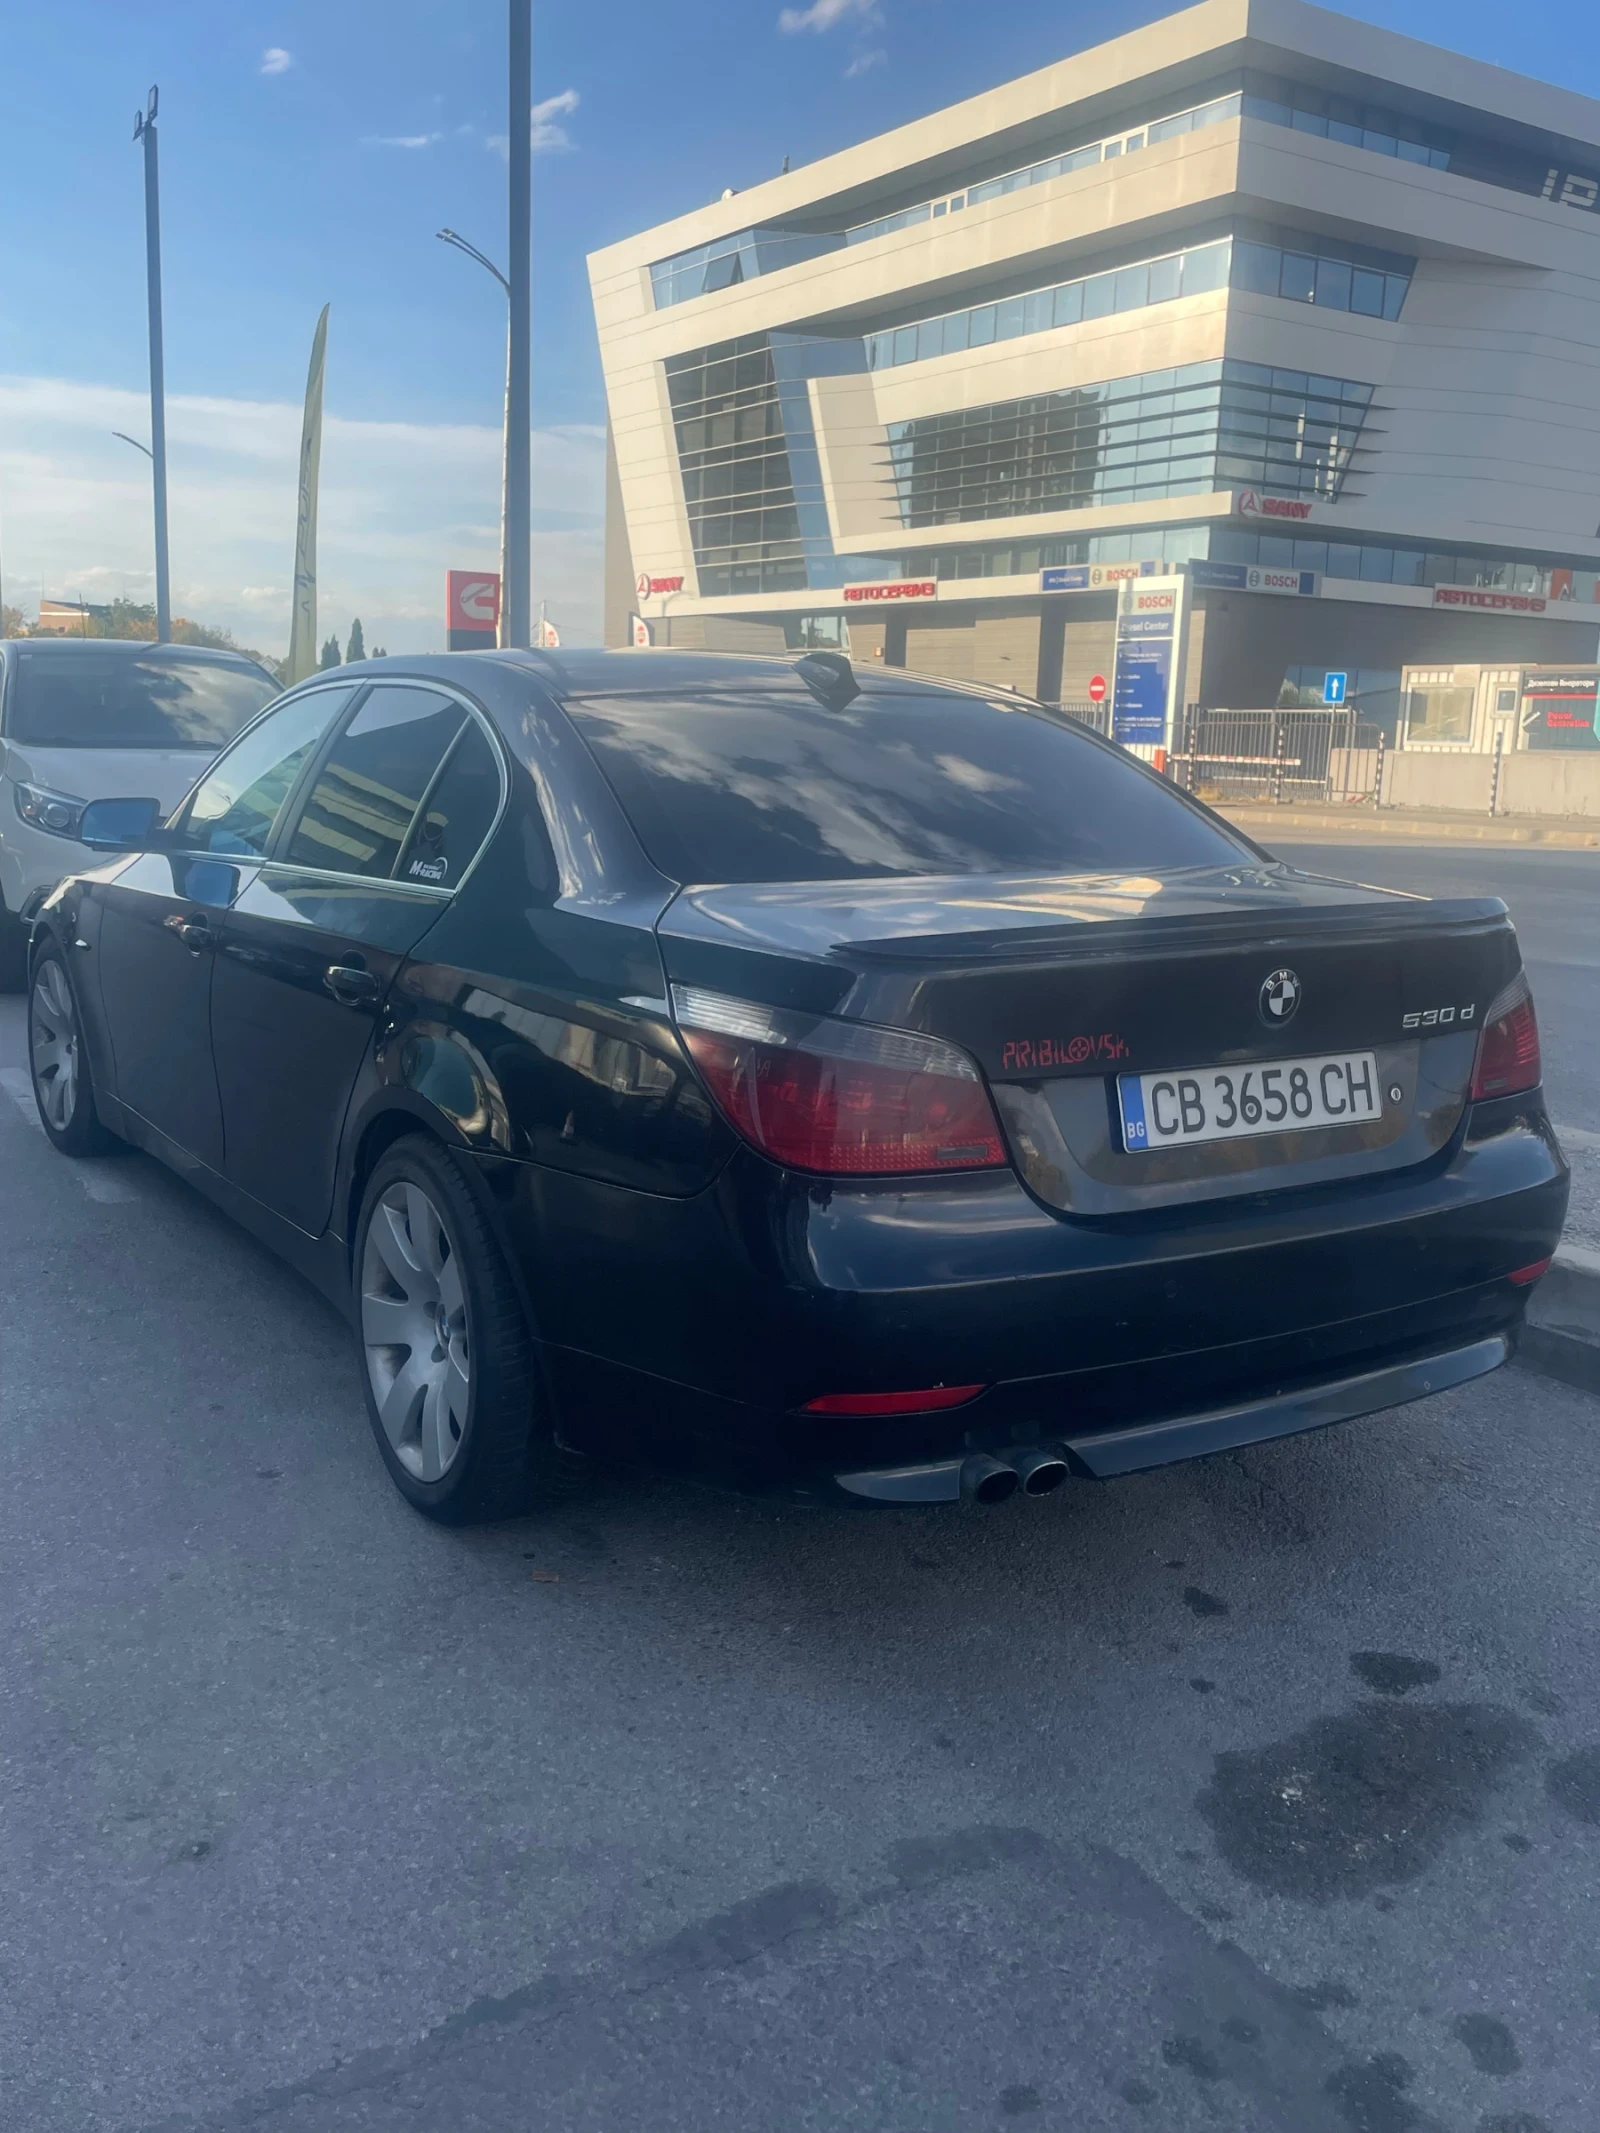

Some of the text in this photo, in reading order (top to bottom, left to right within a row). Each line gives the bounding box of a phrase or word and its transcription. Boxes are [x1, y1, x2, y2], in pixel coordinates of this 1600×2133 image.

[1262, 498, 1313, 519] SANY
[1106, 568, 1139, 582] BOSCH
[1264, 574, 1298, 588] BOSCH
[1138, 595, 1173, 609] BOSCH
[1436, 589, 1546, 612] АВТОСЕРВИЗ
[1144, 621, 1170, 631] Center
[1547, 711, 1573, 720] Power
[1547, 719, 1591, 728] Generation
[1265, 971, 1300, 991] BMW
[1402, 1003, 1475, 1029] 530 d
[1151, 1060, 1374, 1135] CB 3658 CH
[1127, 1121, 1145, 1139] BG
